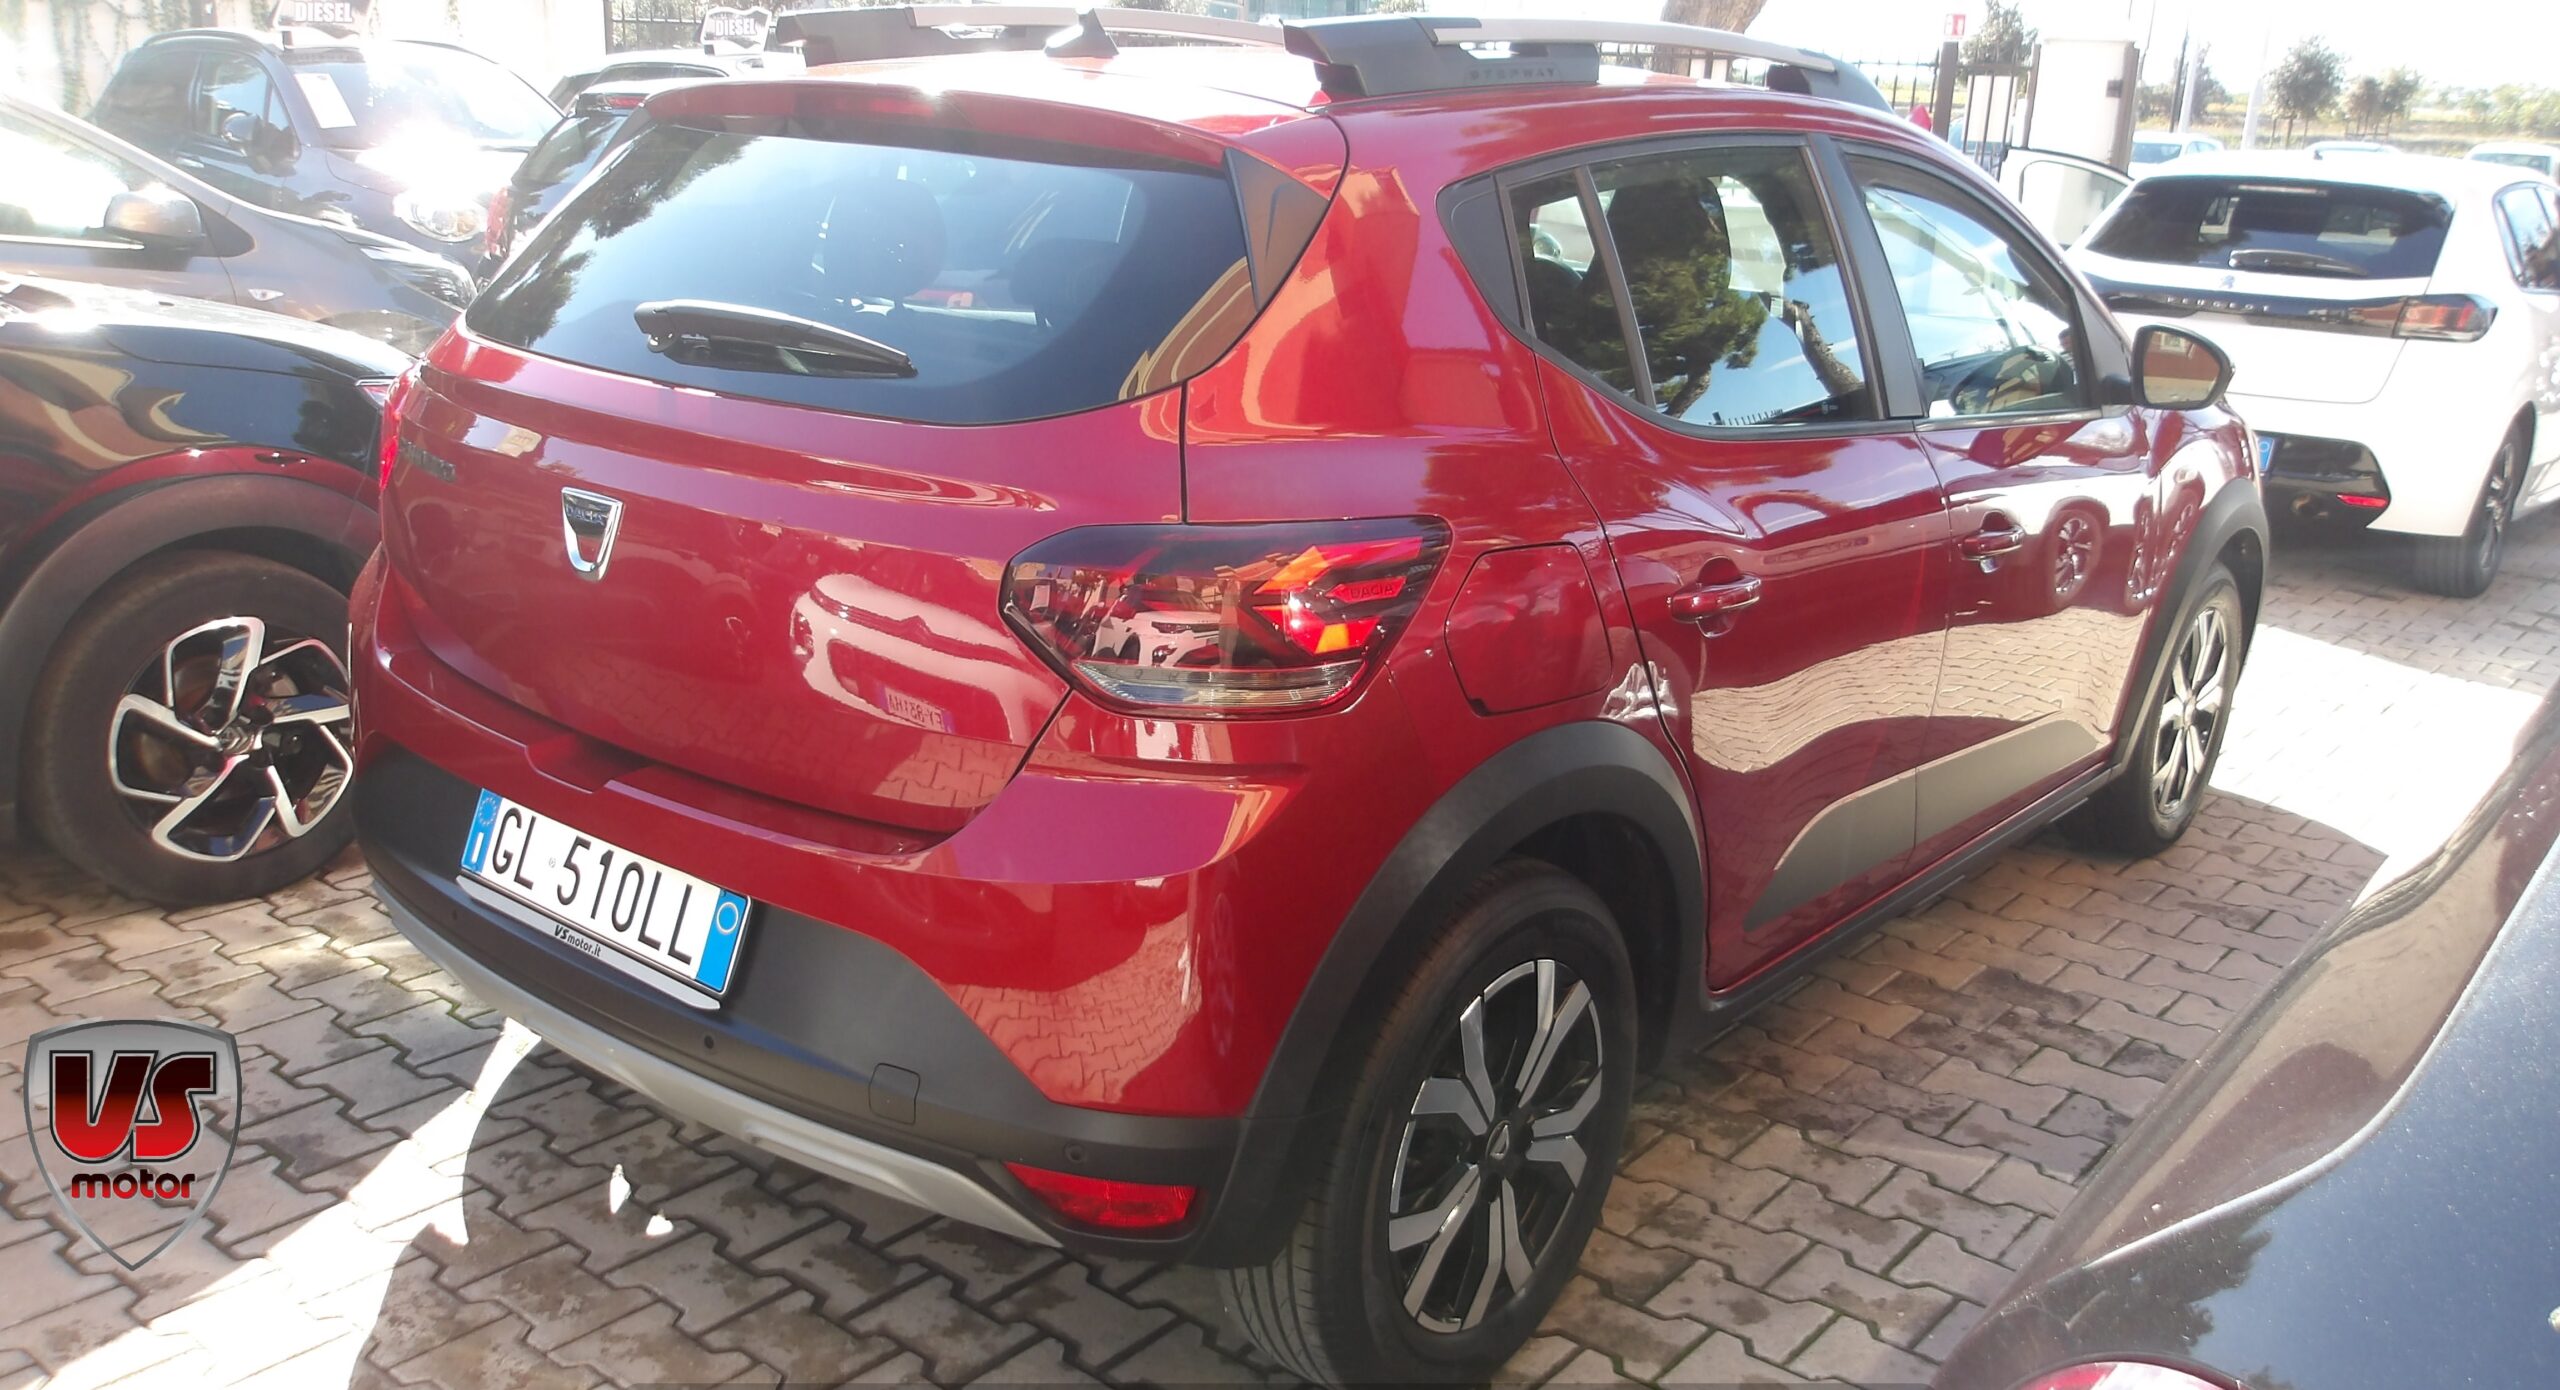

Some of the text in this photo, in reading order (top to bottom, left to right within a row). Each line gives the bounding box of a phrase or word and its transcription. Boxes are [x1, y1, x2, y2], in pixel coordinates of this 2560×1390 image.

[295, 1, 353, 23] DIESEL
[715, 18, 757, 36] DIESEL
[2167, 296, 2269, 312] PEUGEOT
[1350, 583, 1394, 599] DACIA
[492, 807, 693, 965] GL 510LL
